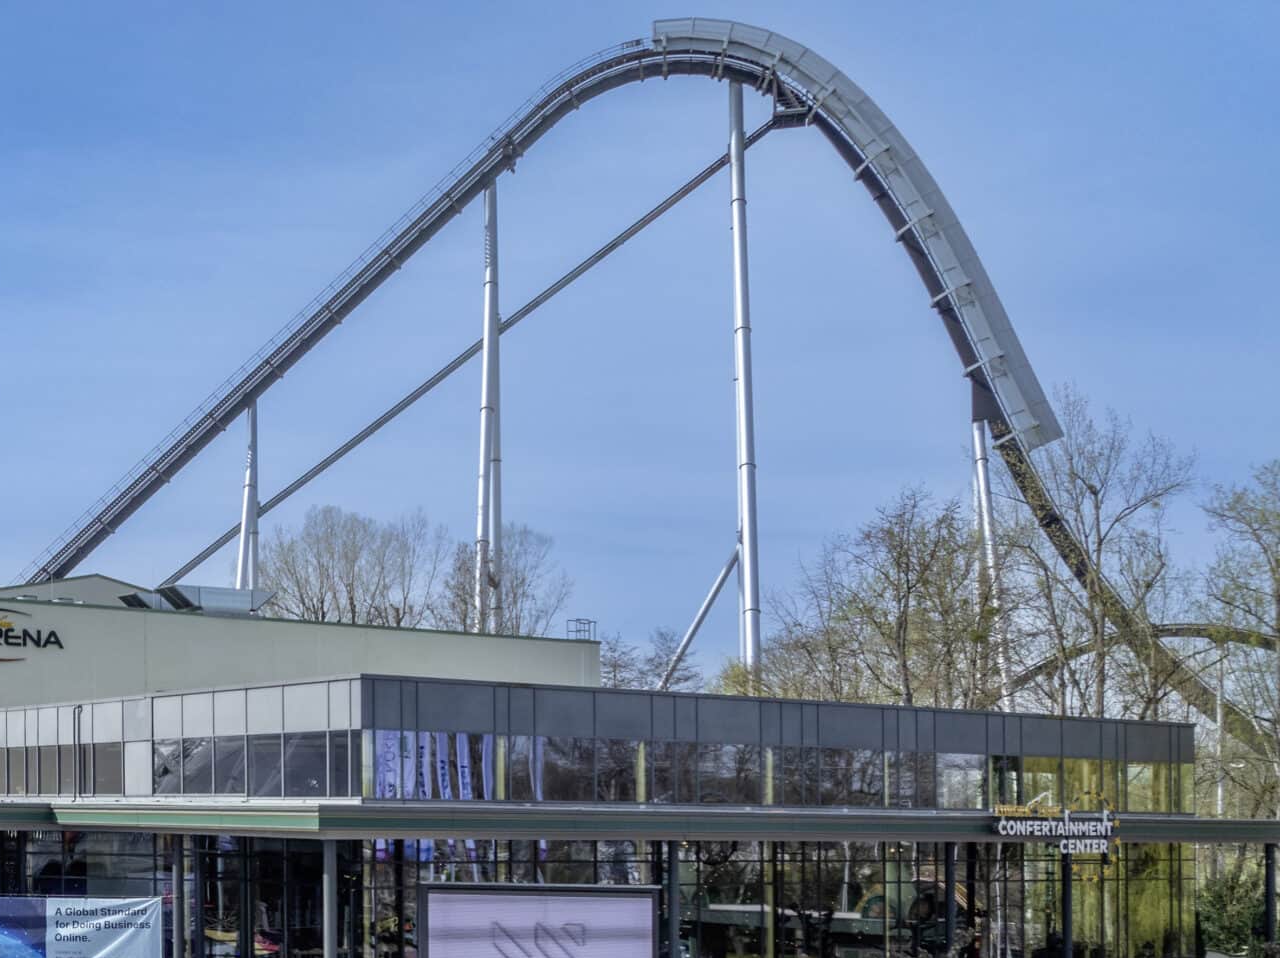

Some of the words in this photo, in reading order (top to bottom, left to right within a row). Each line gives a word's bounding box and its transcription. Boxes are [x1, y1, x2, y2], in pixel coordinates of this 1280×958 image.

[997, 820, 1113, 836] CONFERTAINMENT
[1060, 839, 1108, 853] CENTER
[55, 908, 63, 916] A
[65, 907, 98, 917] Global
[100, 907, 148, 916] Standard
[55, 921, 70, 929] for
[72, 920, 102, 931] Doing
[104, 920, 151, 929] Business
[54, 933, 91, 942] Online.
